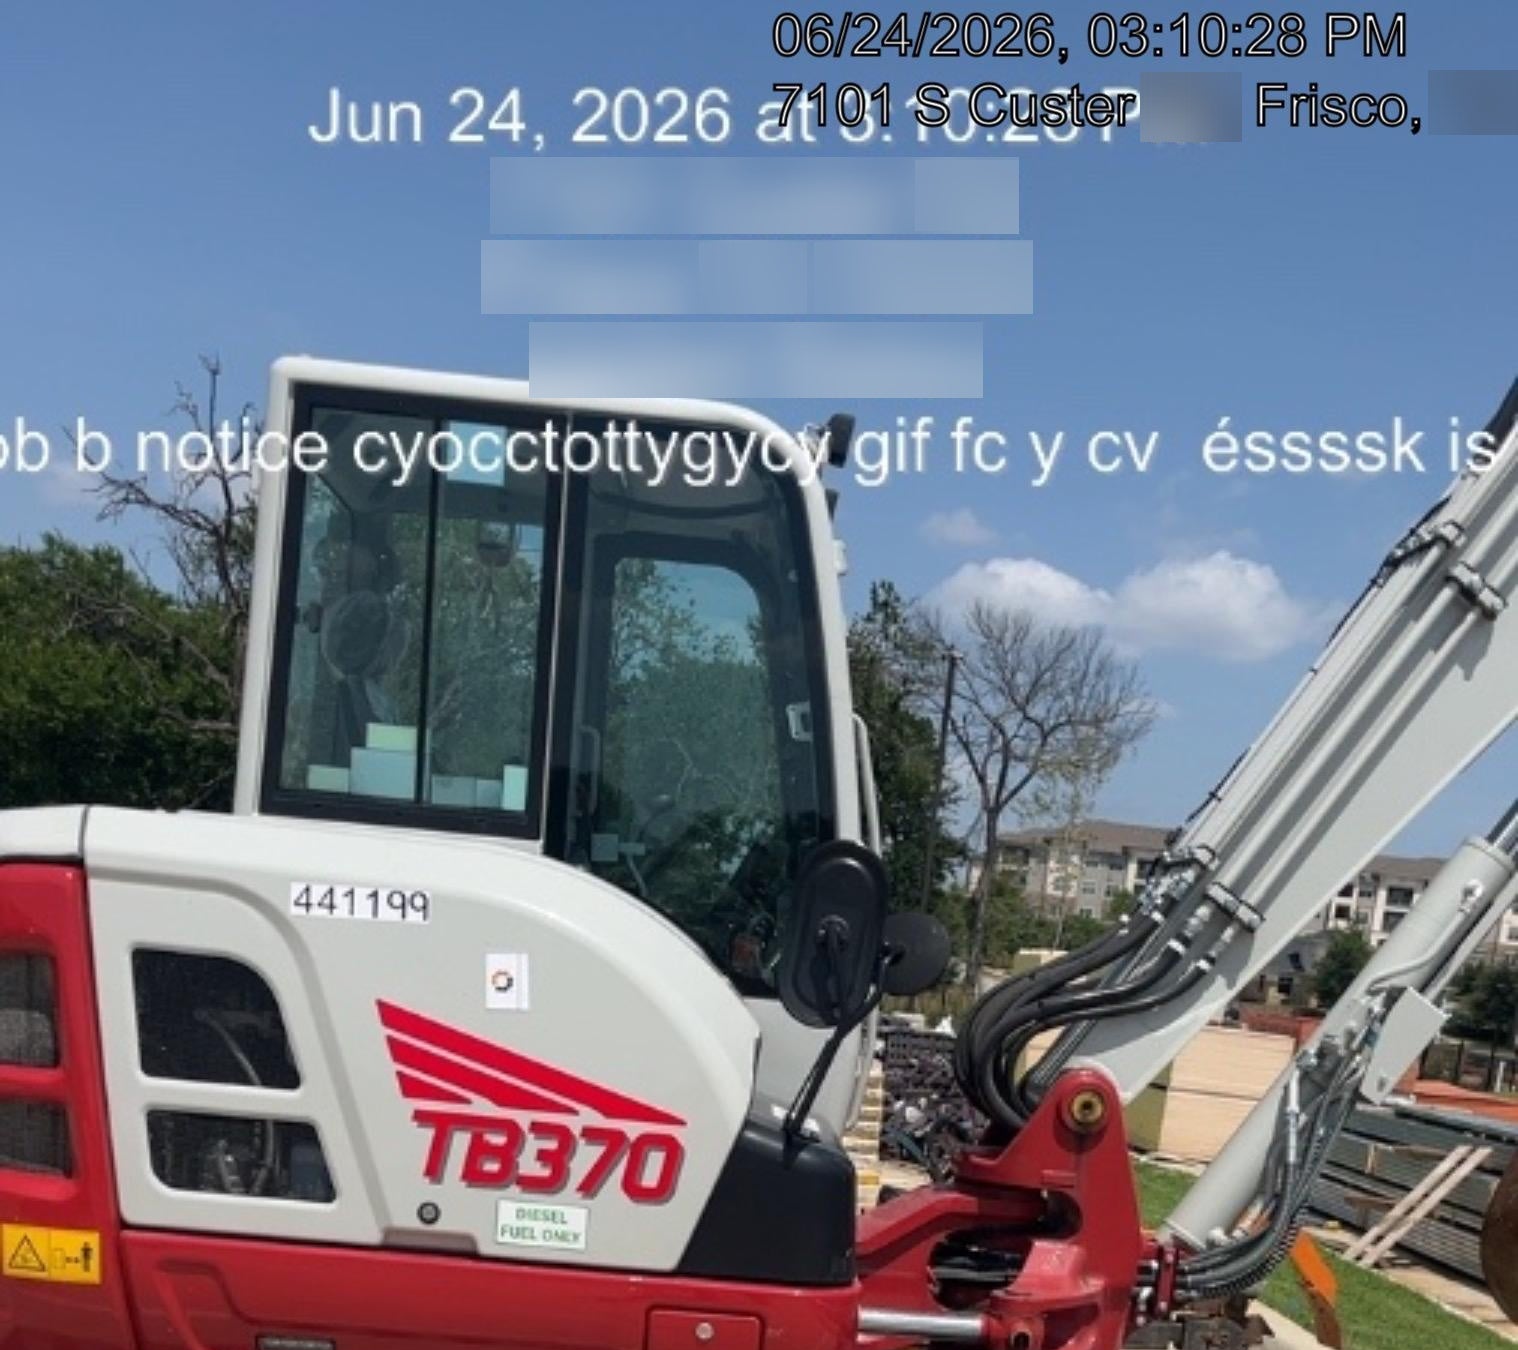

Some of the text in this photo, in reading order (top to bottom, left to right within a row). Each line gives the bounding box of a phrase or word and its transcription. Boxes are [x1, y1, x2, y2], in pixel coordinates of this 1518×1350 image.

[293, 884, 430, 922] 441199
[411, 1109, 685, 1205] TB370
[515, 1206, 568, 1225] DIESEL
[500, 1224, 582, 1243] FUEL ONLY
